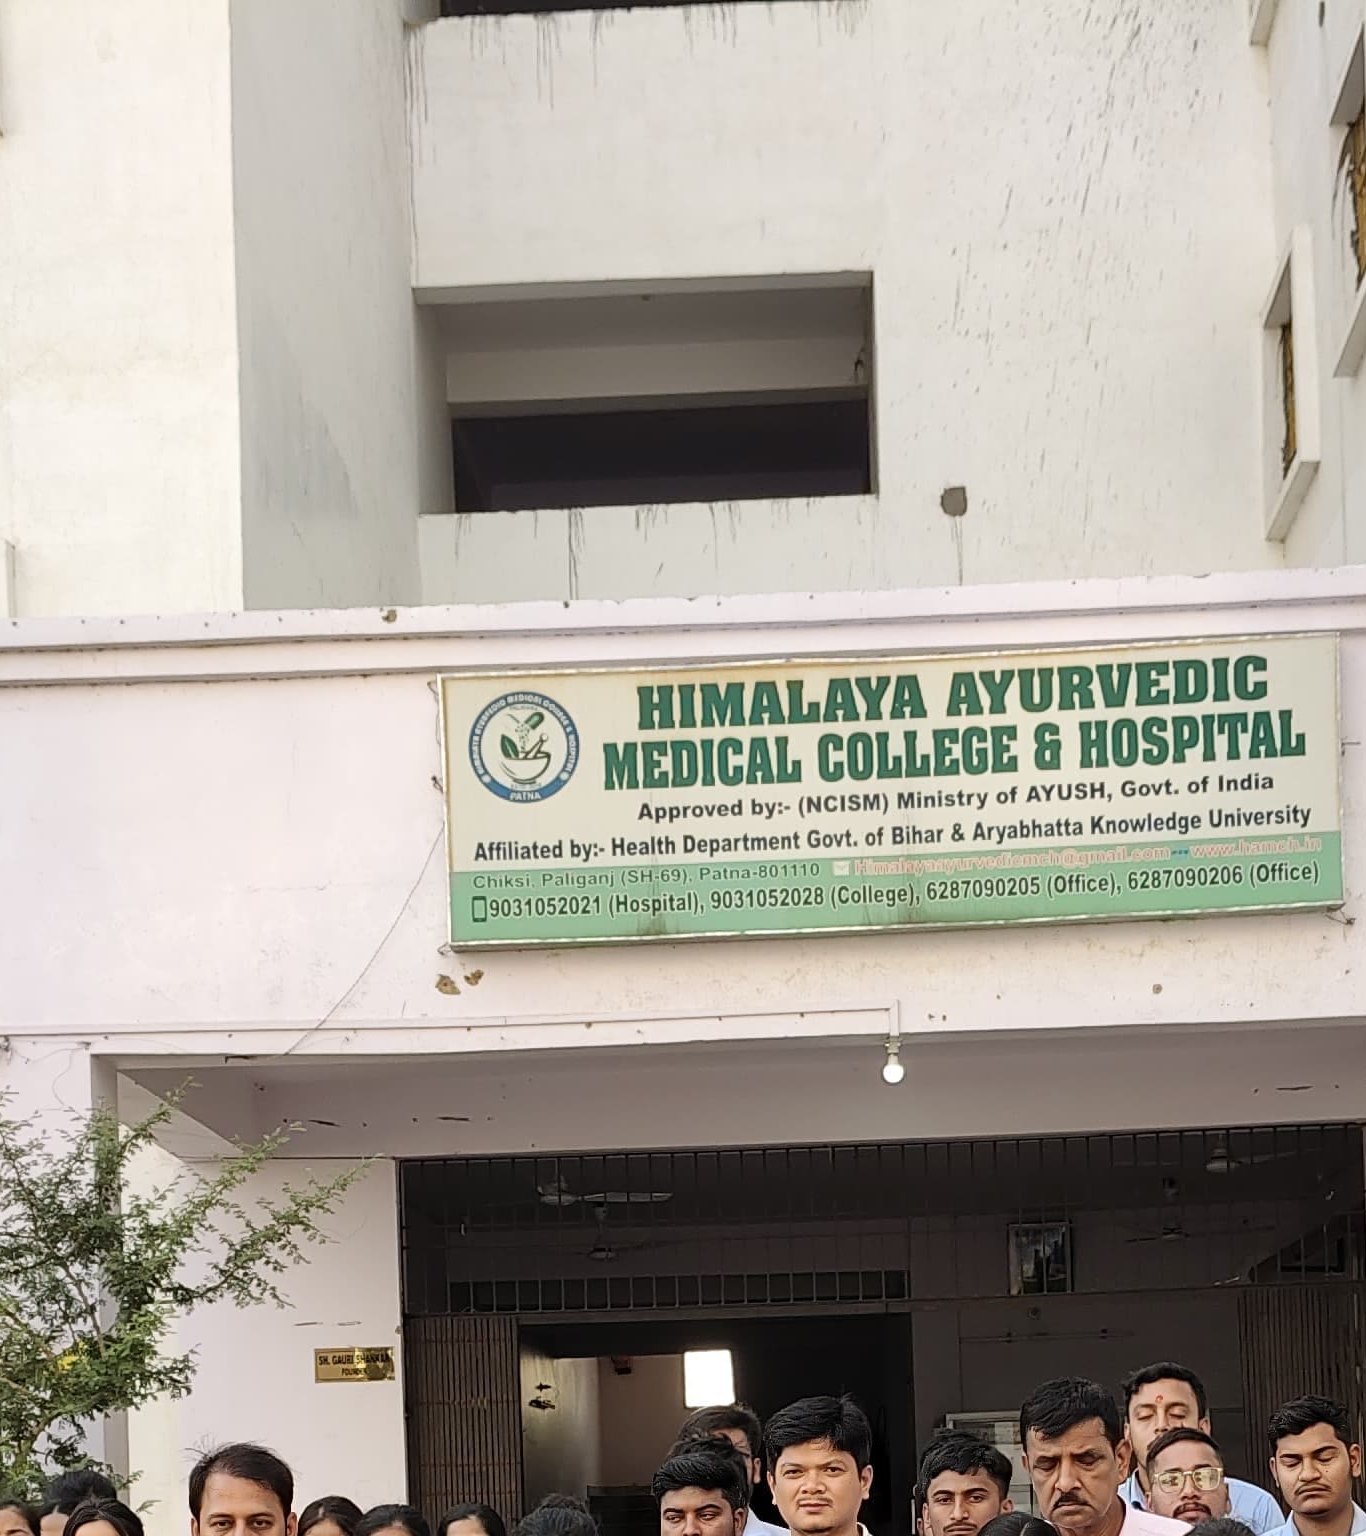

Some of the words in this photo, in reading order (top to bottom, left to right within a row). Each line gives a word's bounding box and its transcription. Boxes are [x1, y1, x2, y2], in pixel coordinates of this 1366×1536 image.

[636, 674, 928, 731] HIMALAYA
[946, 655, 1268, 717] AYURVEDIC
[603, 736, 802, 790] MEDICAL
[817, 725, 1018, 782] COLLEGE
[1034, 722, 1062, 770] &
[1079, 709, 1306, 769] HOSPITAL
[509, 792, 542, 801] PATNA
[637, 800, 743, 823] Approved
[751, 799, 791, 820] by:-
[798, 793, 889, 818] (NCISM)
[897, 791, 988, 810] Ministry
[996, 786, 1017, 804] of
[1026, 781, 1112, 804] AYUSH,
[1121, 777, 1179, 798] Govt.
[1187, 776, 1209, 793] of
[1218, 773, 1274, 793] India
[474, 839, 563, 862] Affiliated
[570, 838, 605, 862] by:-
[611, 836, 676, 857] Health
[683, 831, 800, 857] Department
[807, 828, 858, 849] Govt.
[865, 826, 883, 846] of
[891, 825, 944, 845] Bihar
[950, 823, 965, 842] &
[973, 816, 1083, 844] Aryabhatta
[1090, 811, 1202, 835] Knowledge
[1209, 804, 1312, 829] University
[489, 894, 602, 918] 9031052021
[609, 891, 705, 918] (Hospital),
[710, 886, 824, 911] 9031052028
[831, 883, 921, 911] (College),
[926, 876, 1040, 901] 6287090205
[1047, 873, 1122, 899] (Office),
[1128, 865, 1243, 890] 6287090206
[1250, 861, 1320, 889] (Office)
[542, 870, 615, 889] Paliganj
[621, 867, 693, 887] (SH-69),
[699, 862, 820, 883] Patna-801110
